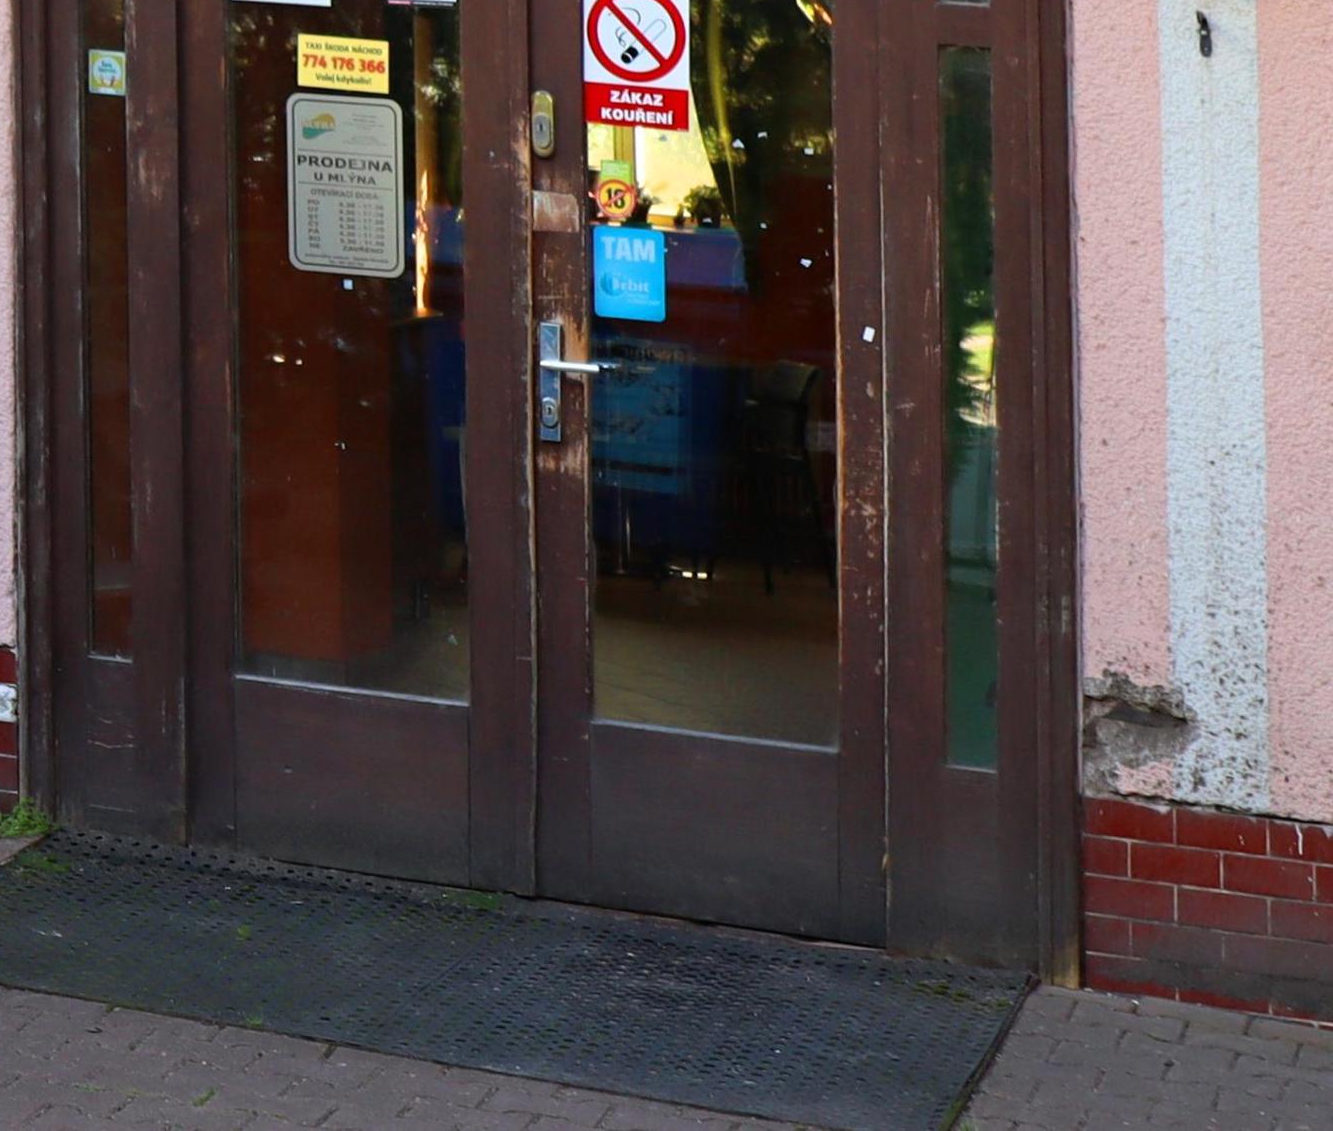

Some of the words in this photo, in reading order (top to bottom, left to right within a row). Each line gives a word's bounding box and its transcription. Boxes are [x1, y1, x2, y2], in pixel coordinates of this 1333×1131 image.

[302, 53, 328, 69] 774
[331, 56, 355, 72] 176
[358, 58, 386, 74] 366
[609, 88, 664, 107] ZÁKAZ
[600, 106, 674, 126] KOUŘENÍ
[297, 154, 393, 174] PRODEJNA
[313, 171, 324, 182] U
[327, 171, 377, 186] MLÝNA
[600, 235, 656, 264] TAM
